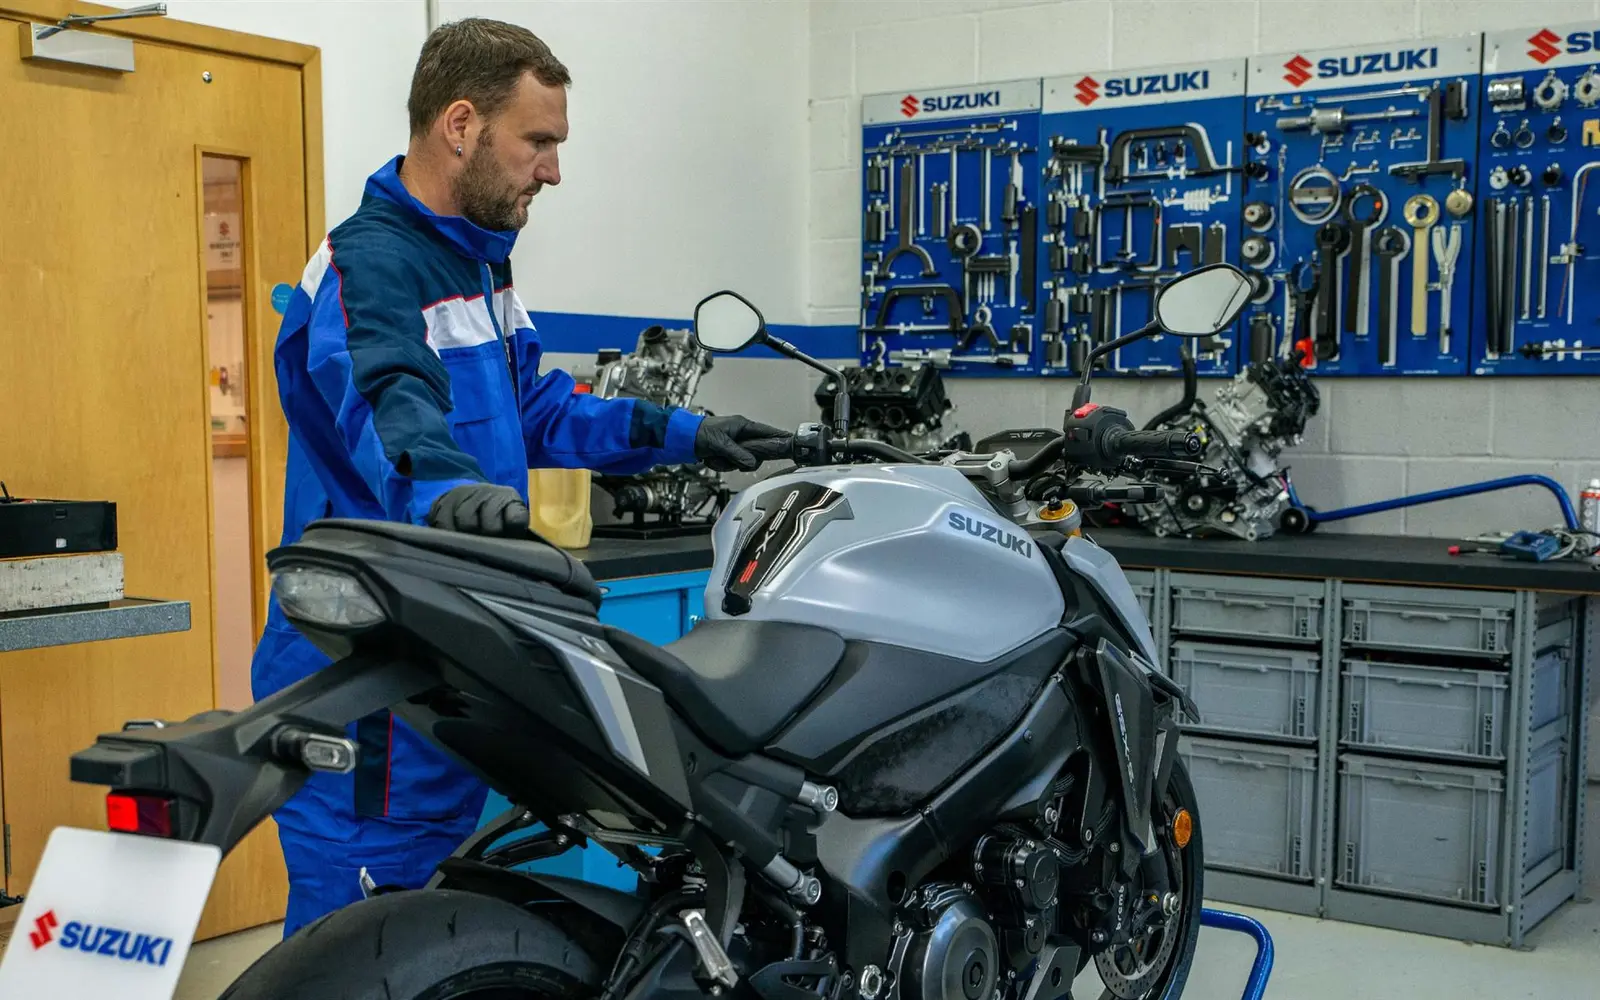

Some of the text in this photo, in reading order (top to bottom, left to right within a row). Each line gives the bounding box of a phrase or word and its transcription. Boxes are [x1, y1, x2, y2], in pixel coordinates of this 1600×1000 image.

[1318, 47, 1438, 79] SUZUKI
[922, 91, 1000, 112] SUZUKI
[1104, 70, 1209, 97] SUZUKI
[740, 490, 799, 583] GSX-S
[948, 511, 1032, 558] SUZUKI
[59, 921, 173, 967] SUZUKI
